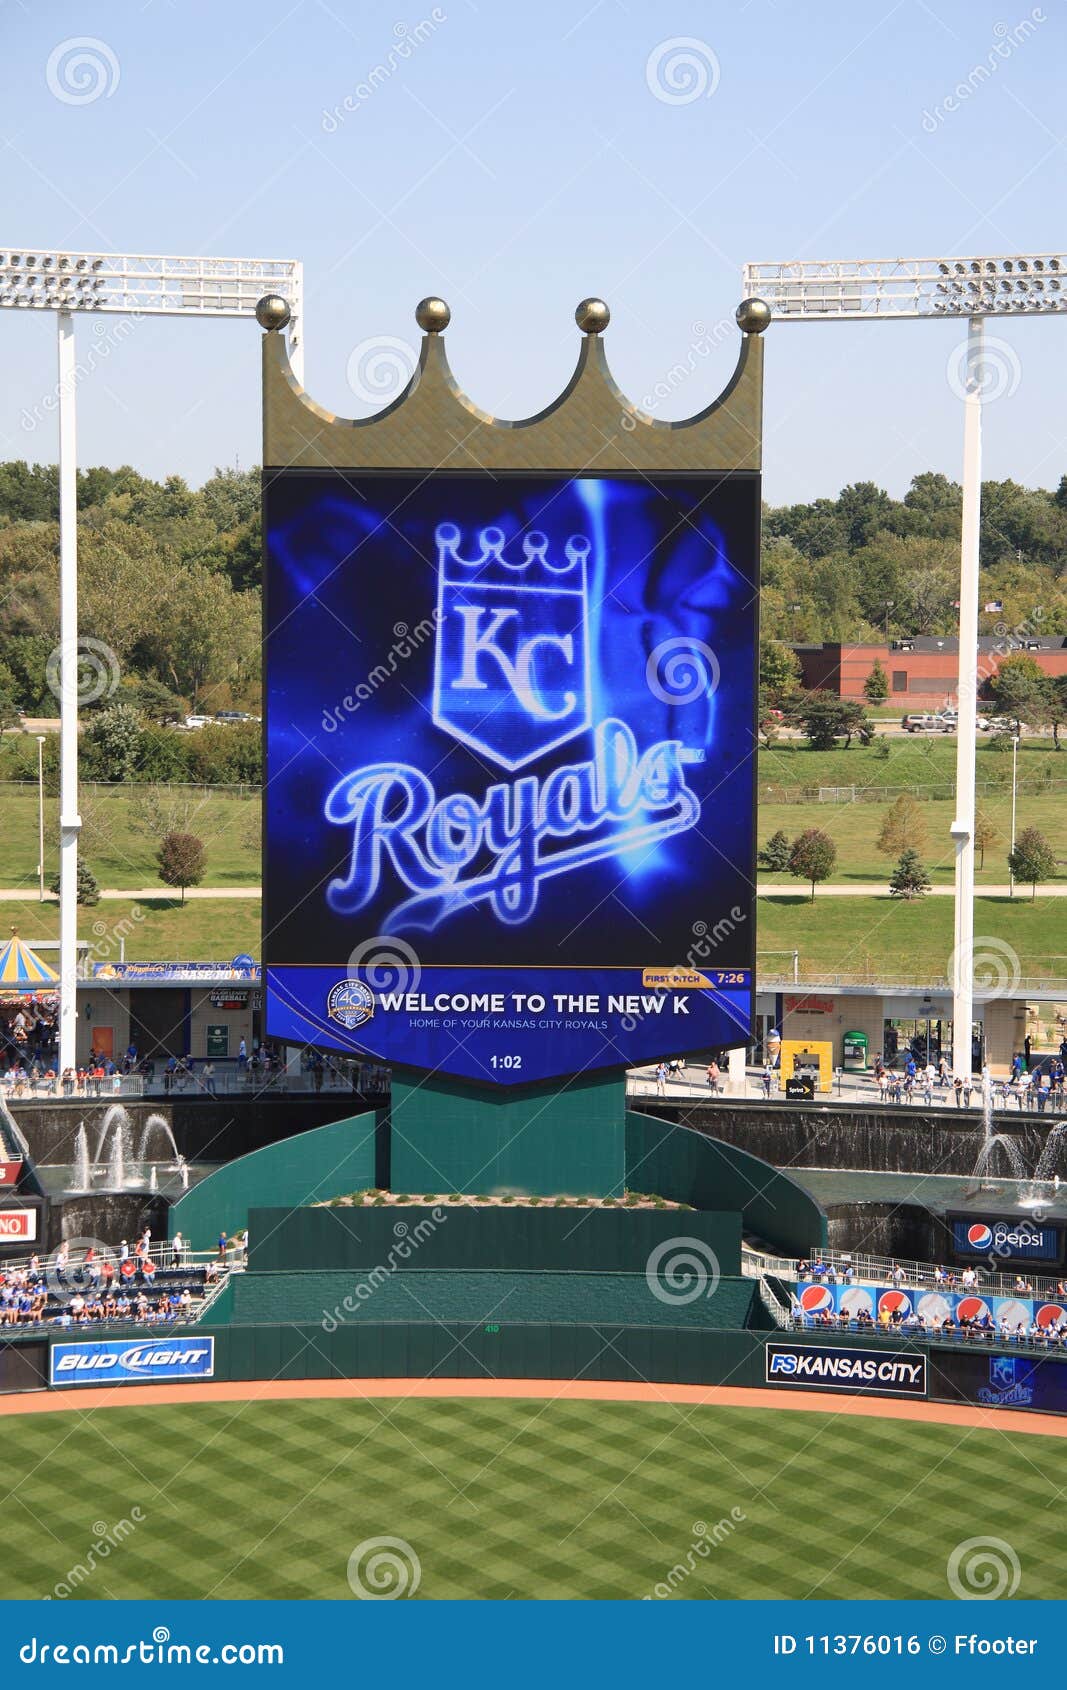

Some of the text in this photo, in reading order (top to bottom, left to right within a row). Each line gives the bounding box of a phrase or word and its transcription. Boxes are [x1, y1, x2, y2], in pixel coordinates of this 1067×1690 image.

[451, 604, 576, 722] KC
[324, 717, 700, 932] Royals
[645, 975, 700, 983] FIRST PITCH
[717, 972, 744, 984] 7:26
[379, 993, 690, 1014] WELCOME TO THE NEW K
[409, 1019, 608, 1029] HOME OF YOUR KANSAS CITY ROYALS
[490, 1055, 522, 1069] 1:02
[788, 1086, 804, 1094] Sprint
[994, 1231, 1044, 1248] pepsi
[484, 1325, 500, 1333] 410
[56, 1349, 209, 1371] BUD LIGHT
[797, 1356, 876, 1380] KANSAS
[878, 1361, 922, 1383] CITY
[992, 1361, 1013, 1384] KC
